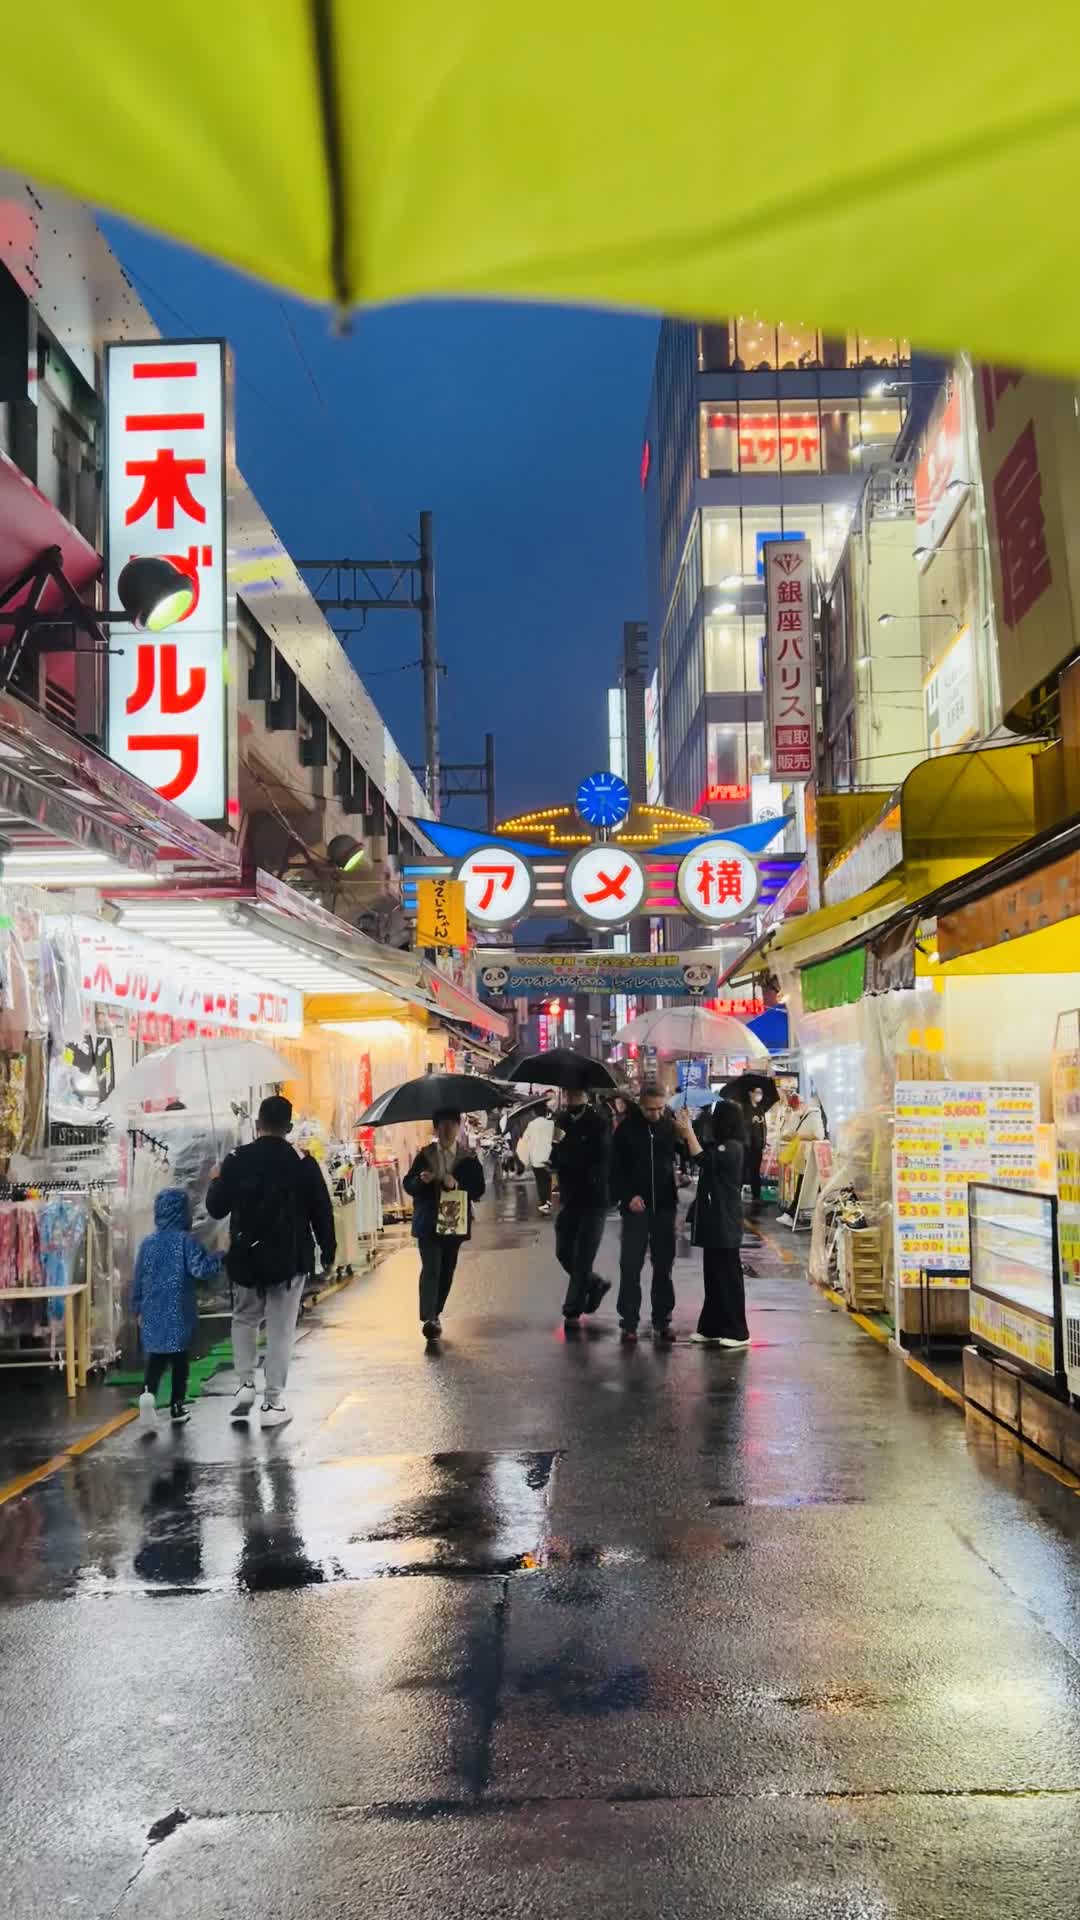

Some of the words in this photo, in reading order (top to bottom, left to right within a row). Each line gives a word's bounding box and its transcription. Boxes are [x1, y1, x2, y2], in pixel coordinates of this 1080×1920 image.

[776, 580, 806, 718] 銀座パリス
[777, 729, 810, 746] 買取
[777, 752, 812, 771] 販売
[471, 859, 743, 911] アメ横
